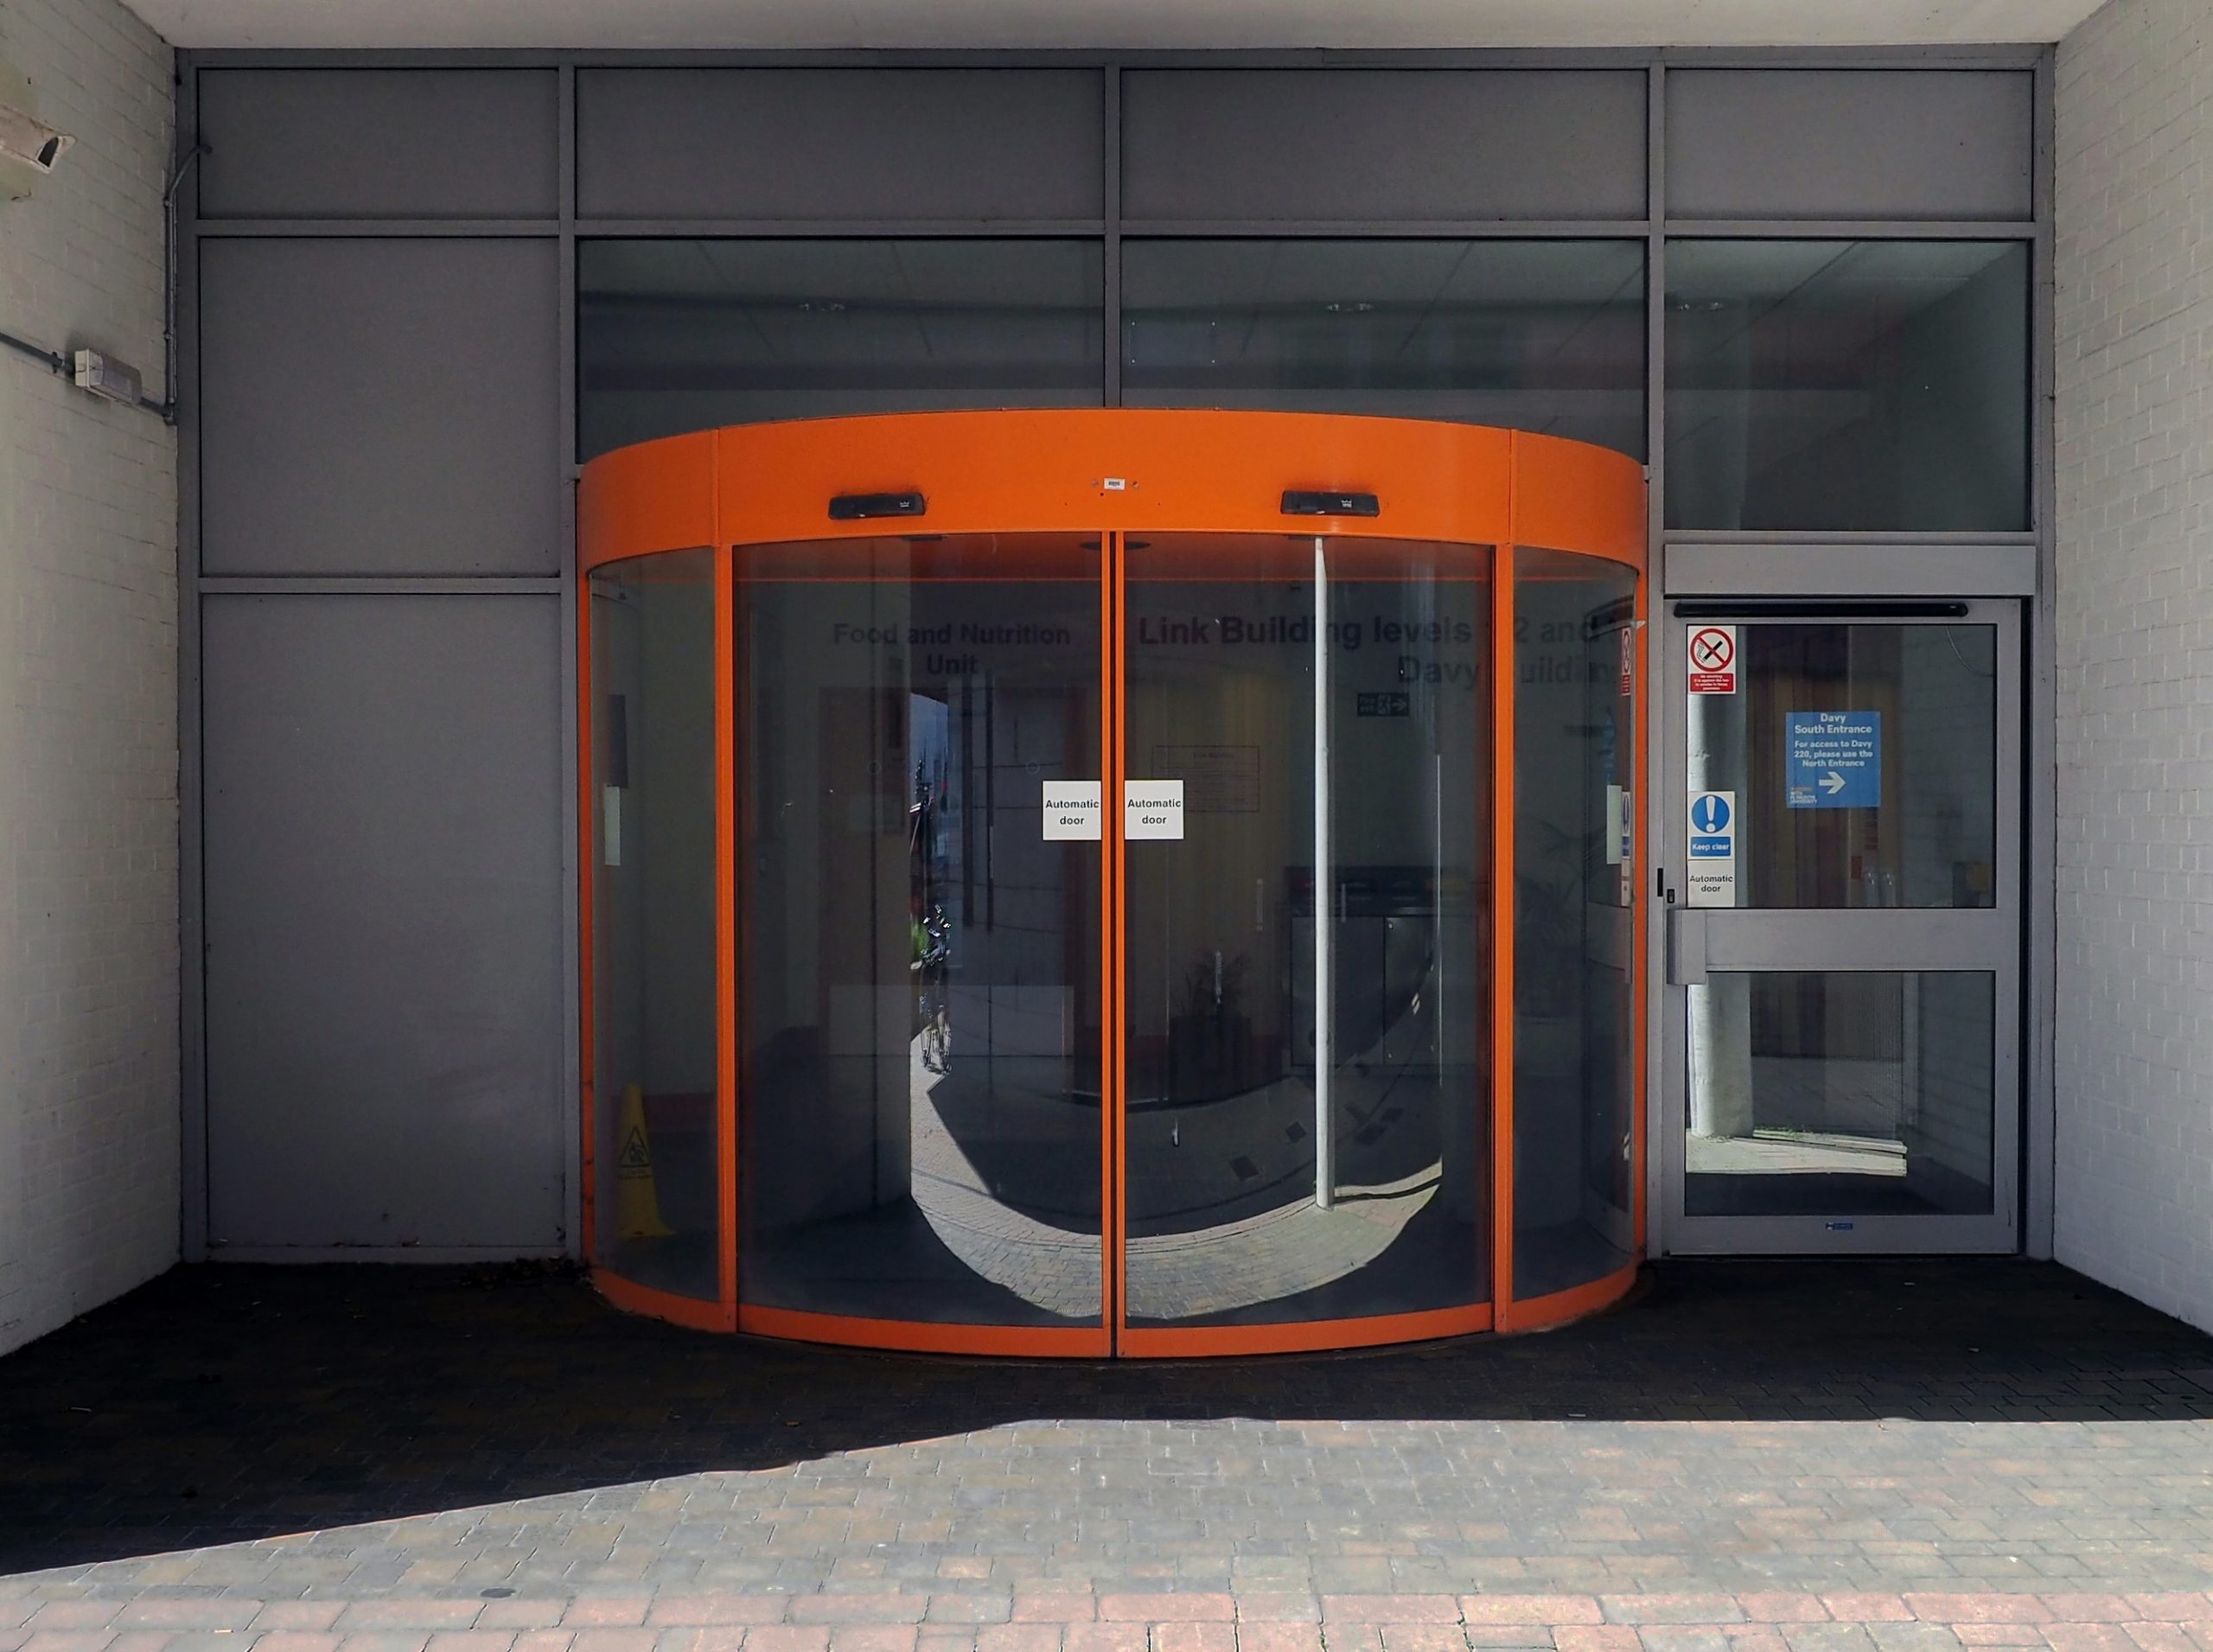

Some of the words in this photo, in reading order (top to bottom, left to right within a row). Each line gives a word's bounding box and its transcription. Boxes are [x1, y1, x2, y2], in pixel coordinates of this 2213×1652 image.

[833, 623, 898, 644] Food
[908, 623, 952, 645] and
[960, 623, 1071, 645] Nutrition
[1138, 616, 1209, 645] Link
[1373, 615, 1472, 643] levels
[926, 654, 978, 675] Unit
[1397, 654, 1480, 692] Davy
[1820, 712, 1846, 724] Davy
[1795, 724, 1825, 734] South
[1827, 724, 1873, 734] Entrance
[1795, 740, 1808, 749] For
[1851, 739, 1872, 749] Davy
[1794, 749, 1812, 759] 220,
[1814, 749, 1840, 760] please
[1859, 749, 1873, 758] the
[1802, 759, 1827, 768] North
[1827, 759, 1865, 768] Entrance
[1045, 799, 1100, 809] Automatic
[1127, 798, 1182, 808] Automatic
[1059, 815, 1085, 826] door
[1141, 815, 1167, 825] door
[1692, 843, 1711, 852] Keep
[1689, 874, 1733, 883] Automatic
